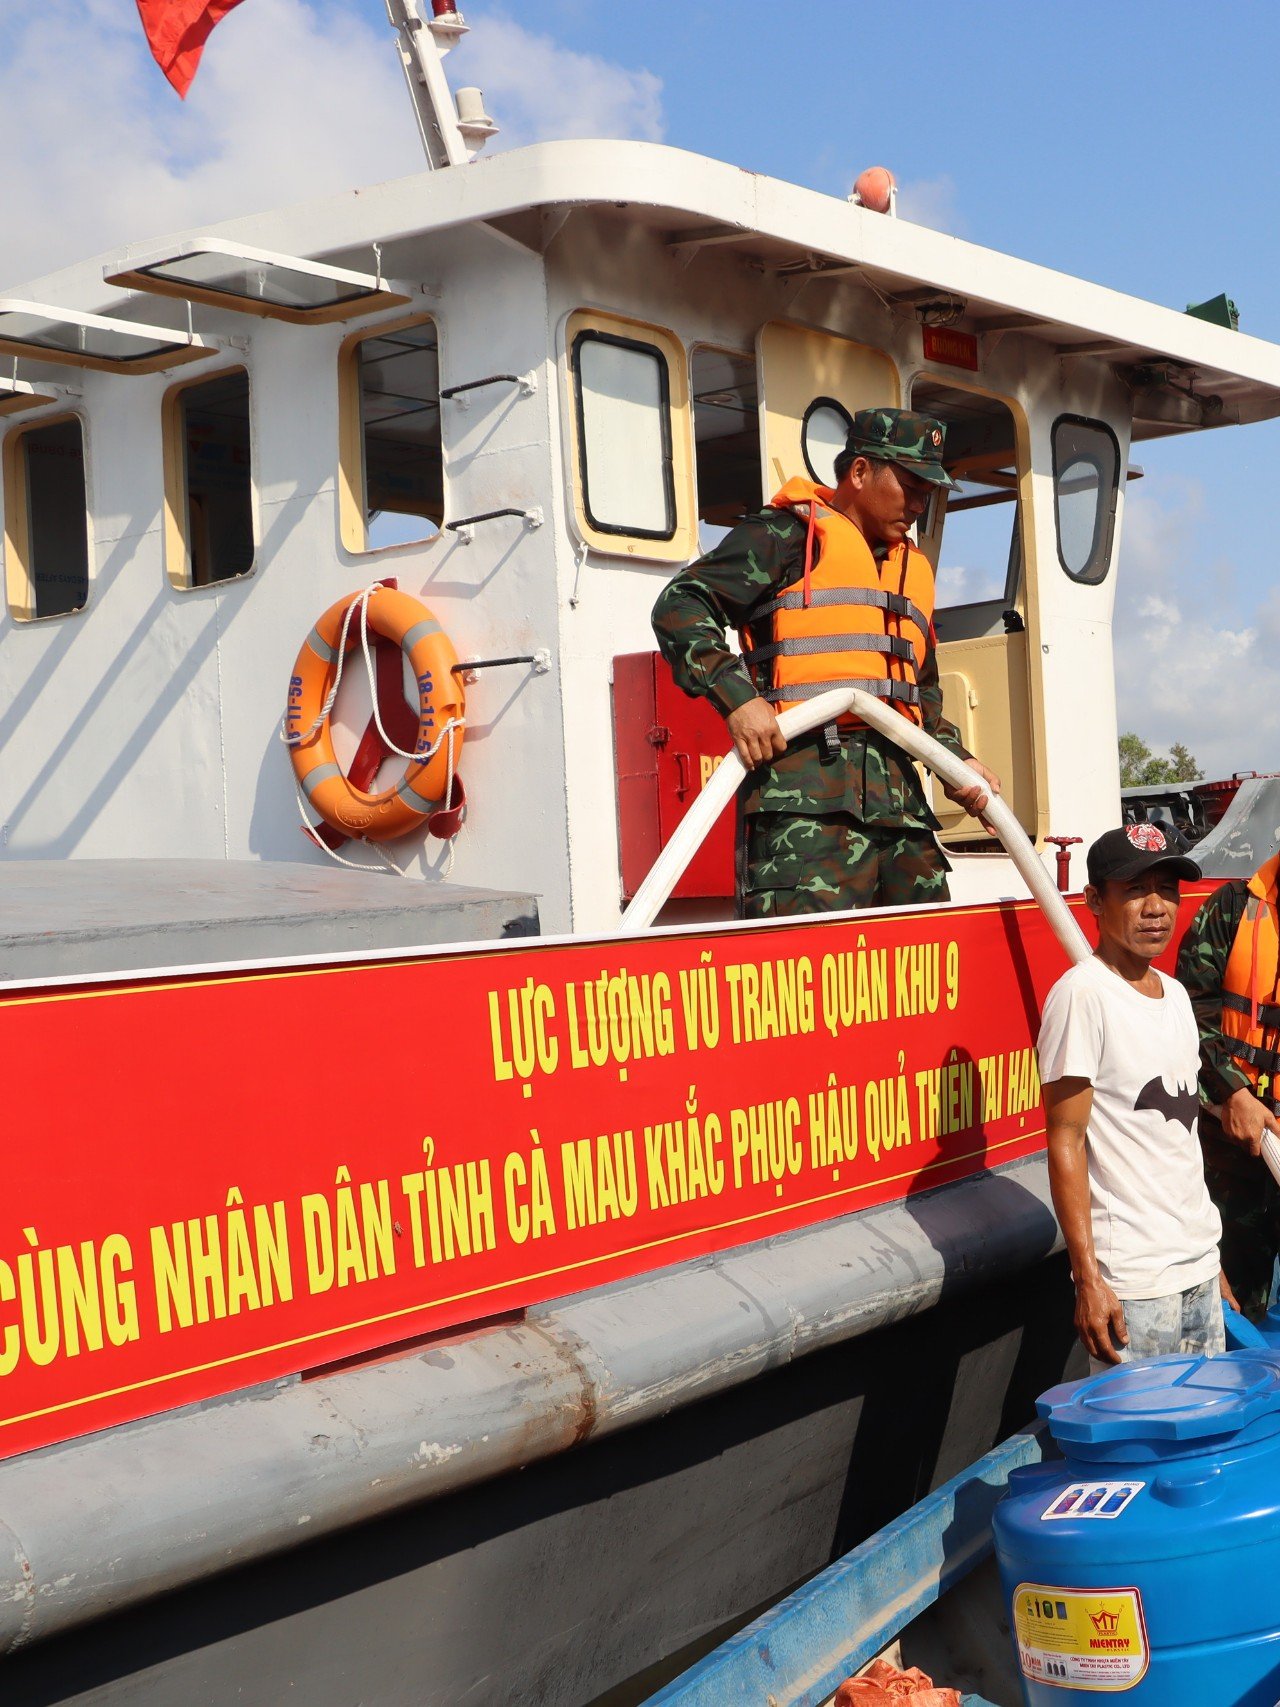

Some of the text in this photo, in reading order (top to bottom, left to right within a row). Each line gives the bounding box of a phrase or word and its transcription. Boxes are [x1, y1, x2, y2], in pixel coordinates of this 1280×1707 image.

[488, 934, 960, 1098] LỰC LƯỢNG VŨ TRANG QUÂN KHU 9
[150, 1186, 293, 1334] NHÂN
[301, 1165, 396, 1295] DÂN
[402, 1136, 497, 1269] TỈNH
[503, 1128, 557, 1244] CÀ
[561, 1122, 638, 1231] MAU
[643, 1085, 725, 1210] KHẮC
[730, 1096, 803, 1197] PHỤC
[809, 1072, 859, 1182] HẬU
[864, 1049, 913, 1162] QUẢ
[915, 1050, 974, 1142] THIÊN
[978, 1053, 1004, 1124] TAI
[1007, 1046, 1041, 1128] HẠN
[1089, 1638, 1130, 1649] MIENTAY
[1091, 1611, 1118, 1631] MT
